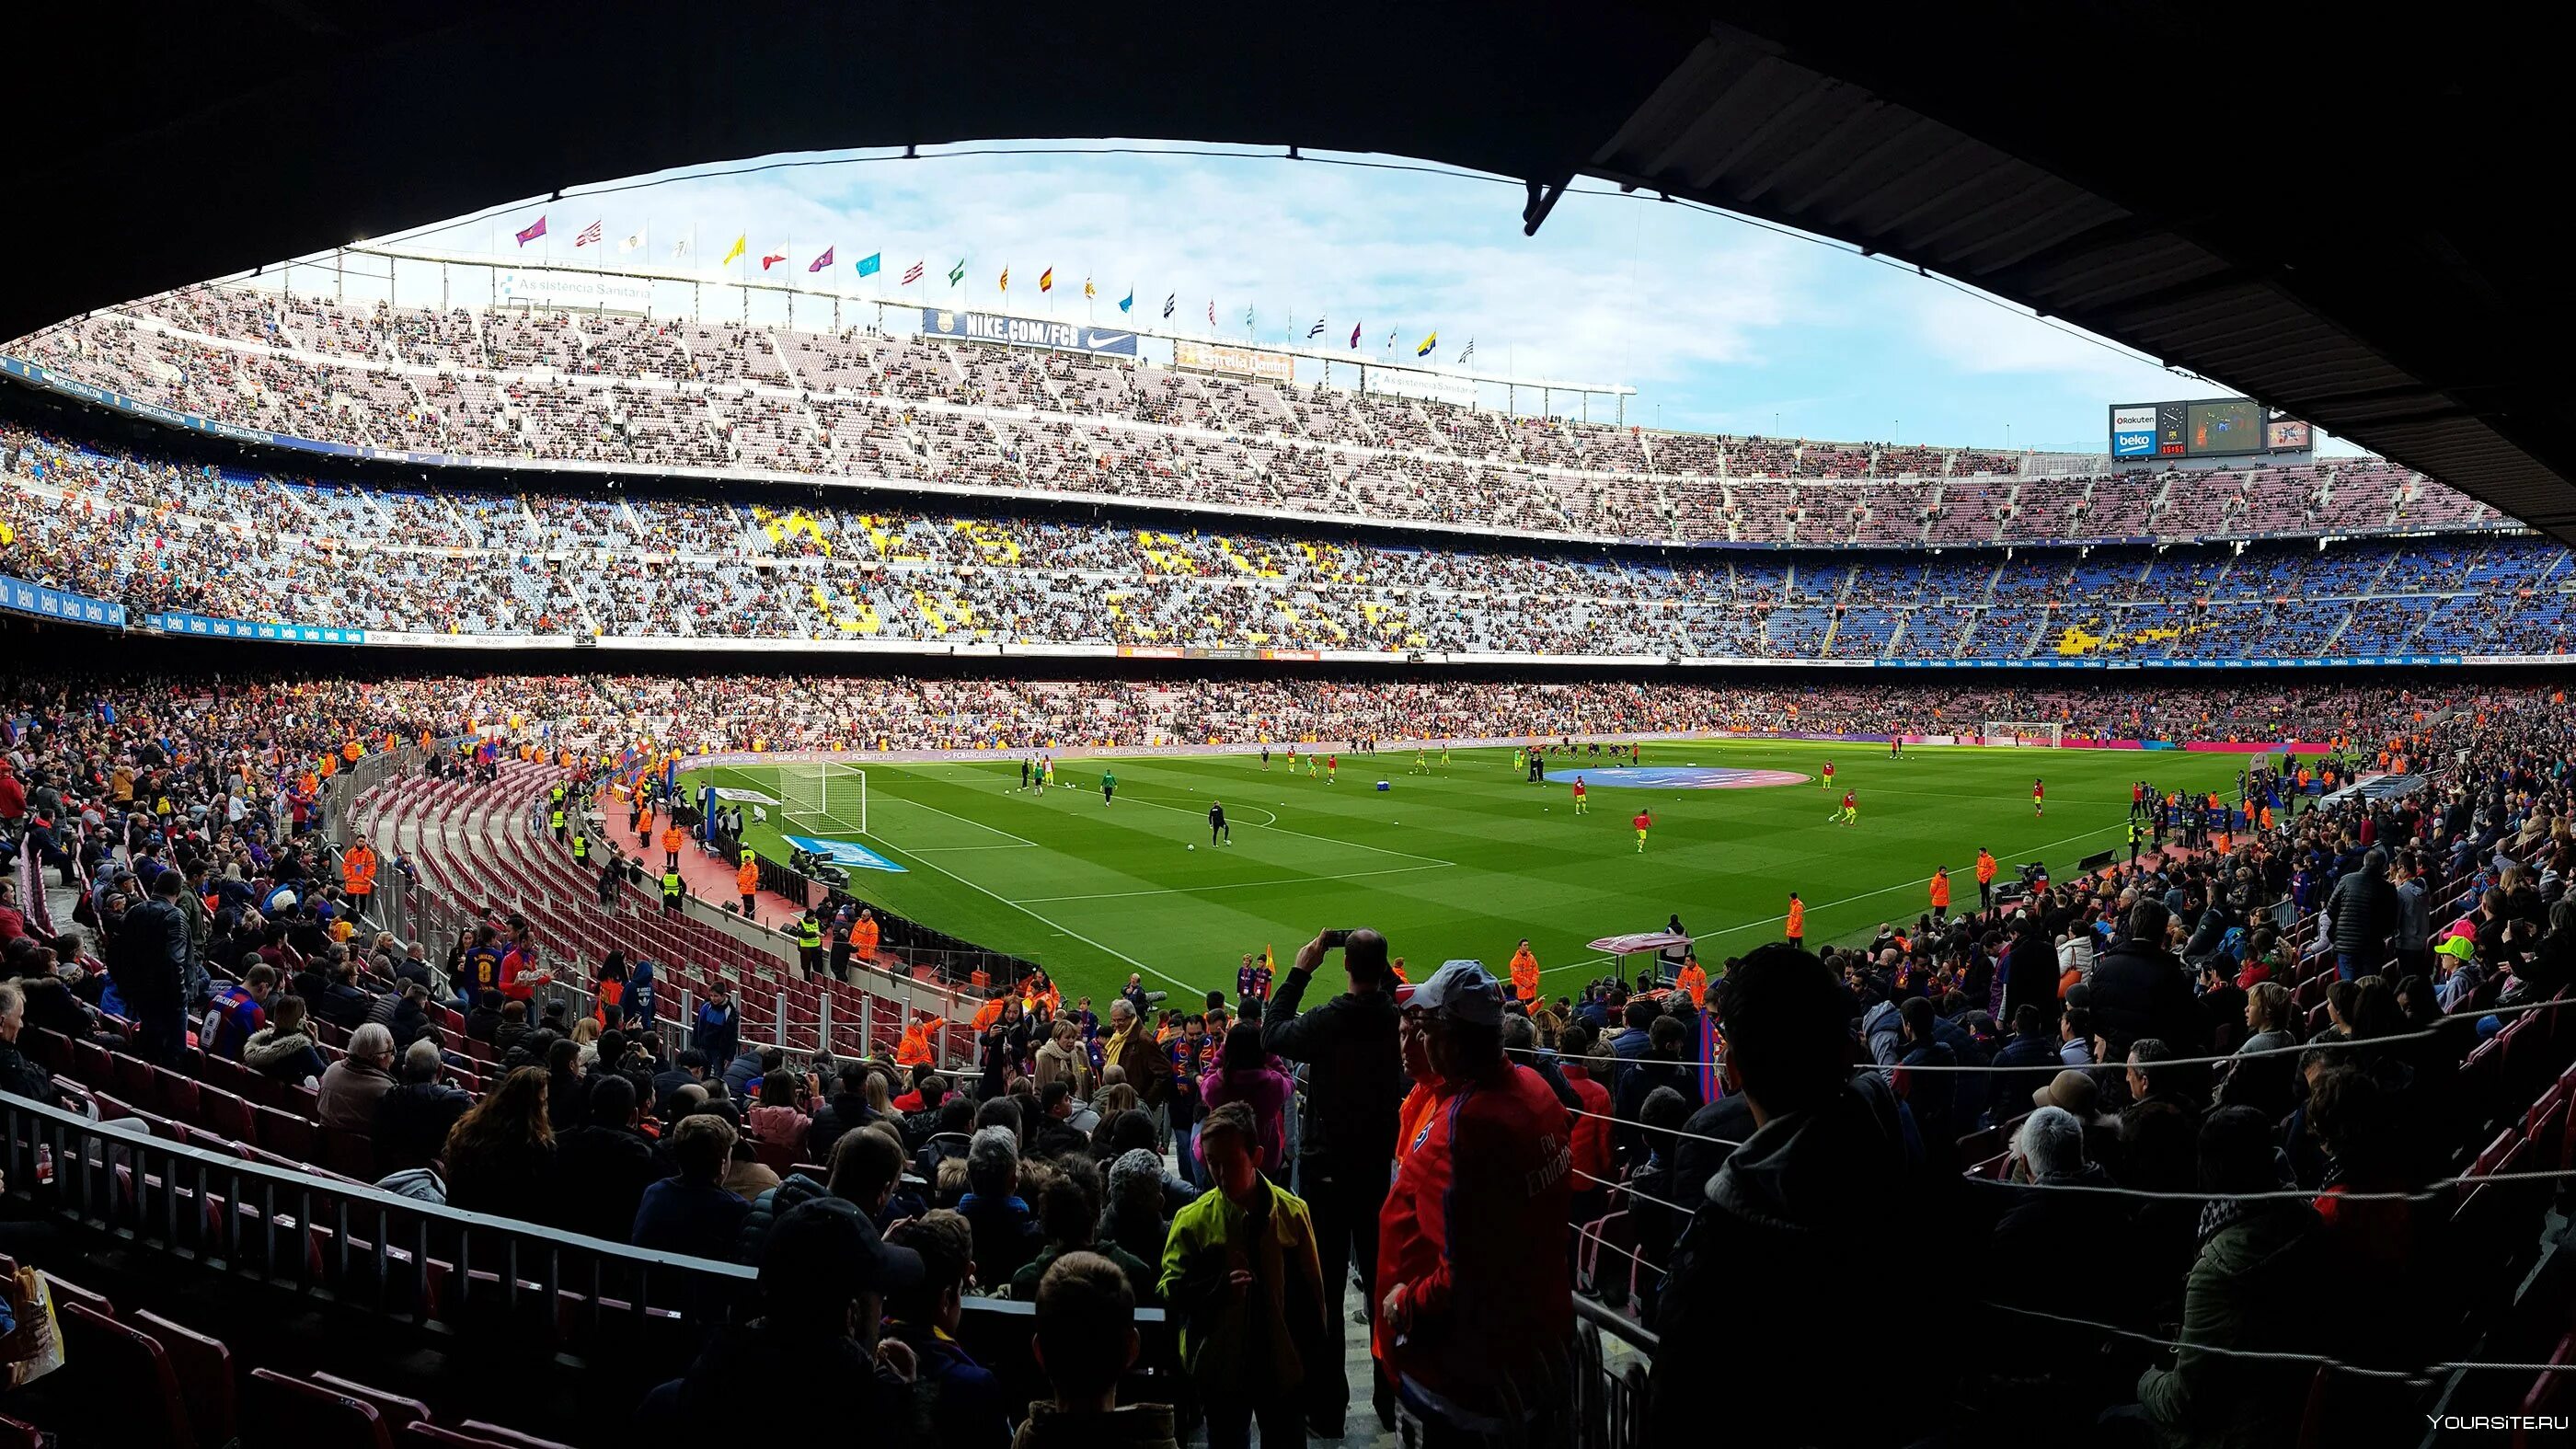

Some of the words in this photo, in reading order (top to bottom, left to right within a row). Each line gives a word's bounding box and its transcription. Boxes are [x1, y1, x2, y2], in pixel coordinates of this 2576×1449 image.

[966, 314, 1079, 346] NIKE.COM/FCB
[131, 401, 186, 423] FCBARCELONA.COM
[2123, 416, 2155, 424] Rakuten
[214, 423, 274, 443] FCBARCELONA.COM
[2120, 435, 2150, 445] beko
[2162, 445, 2184, 454] 15:51
[17, 584, 33, 609] beko
[40, 592, 57, 613] beko
[63, 597, 80, 618] beko
[86, 603, 102, 621] beko
[109, 605, 120, 623] bek
[167, 615, 183, 630] beko
[190, 618, 206, 632] beko
[213, 621, 229, 635] beko
[236, 623, 252, 636] beko
[259, 625, 274, 638] beko
[282, 627, 296, 638] beko
[305, 628, 319, 640] beko
[325, 629, 339, 640] beko
[346, 631, 361, 641] beko
[1982, 659, 1998, 667] beko
[2007, 659, 2023, 667] beko
[2032, 659, 2049, 667] beko
[2058, 659, 2075, 667] beko
[1095, 747, 1179, 755] FCBARCELONA.COM/TICKETS
[478, 961, 491, 983] 8
[201, 1009, 221, 1048] 8
[1540, 1133, 1557, 1155] Fly
